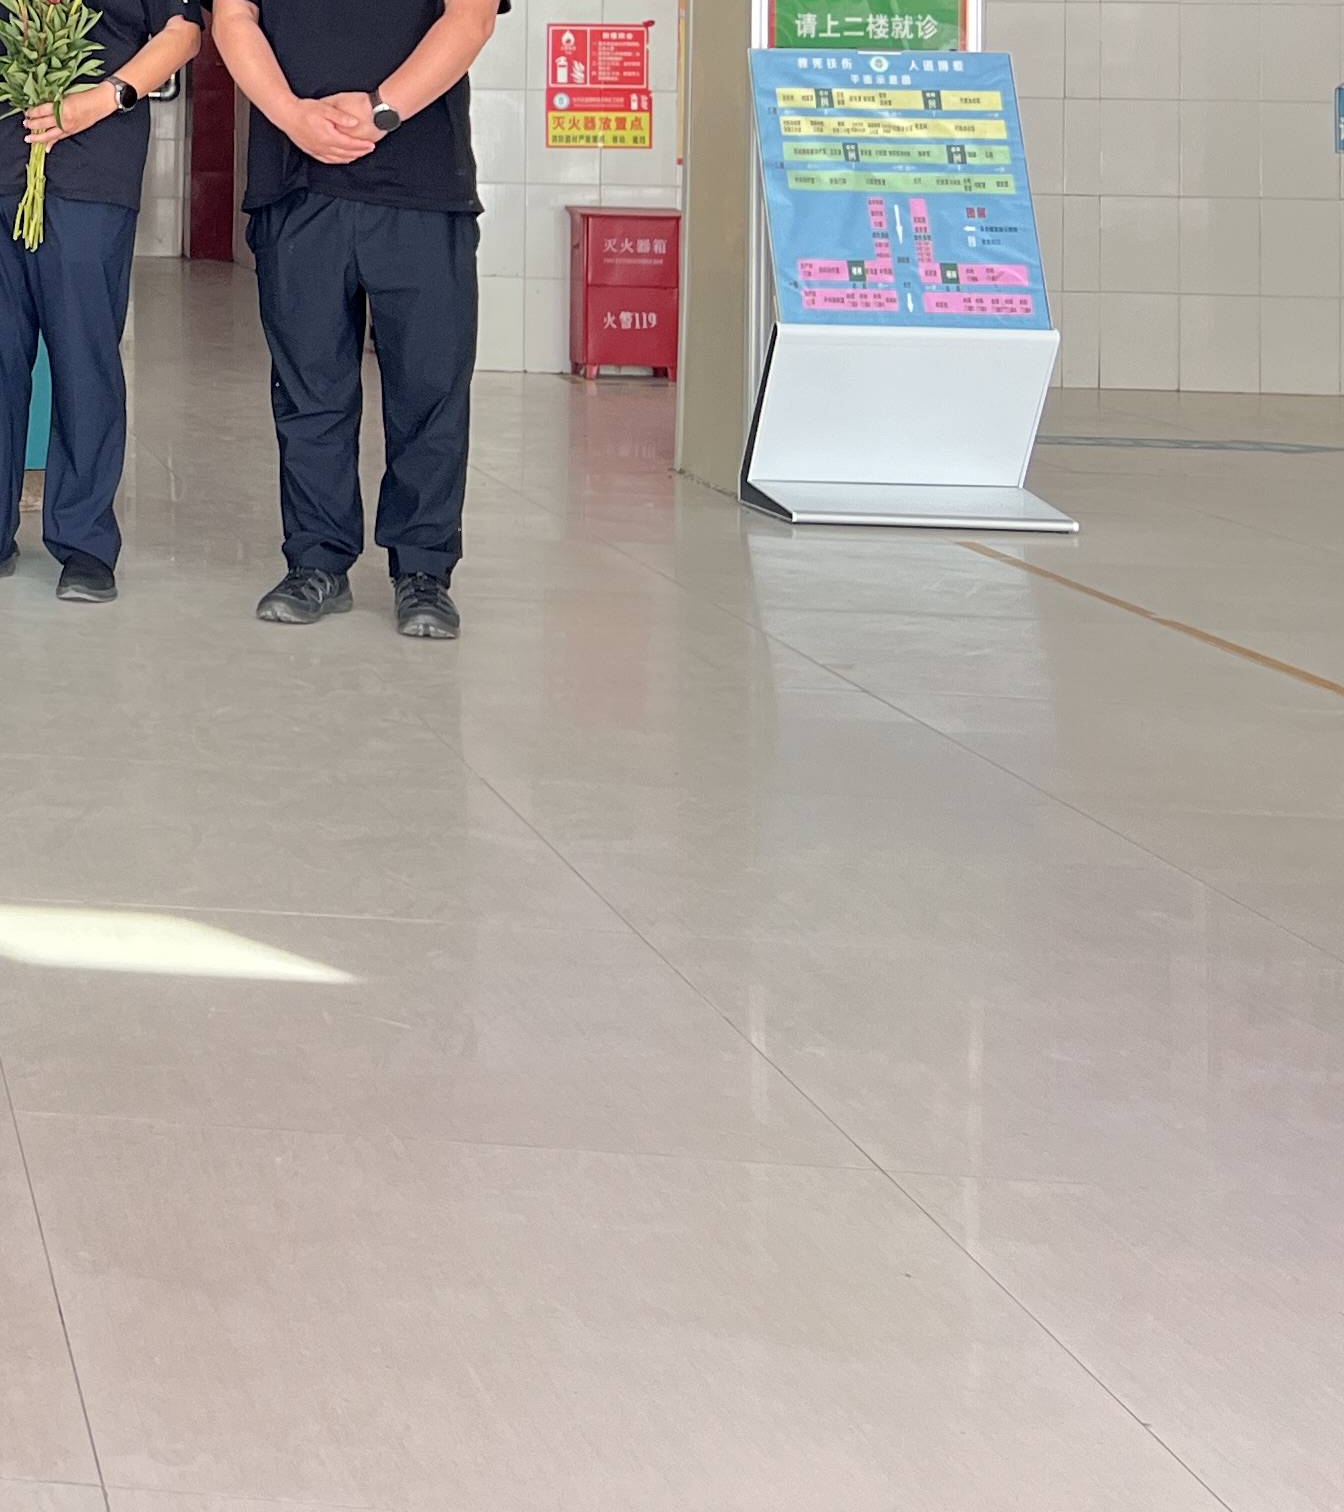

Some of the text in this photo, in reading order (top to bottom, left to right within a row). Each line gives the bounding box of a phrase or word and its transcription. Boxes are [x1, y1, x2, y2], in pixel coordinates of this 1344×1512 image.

[795, 14, 938, 39] 请上二楼就诊
[551, 115, 645, 131] 灭火器放置点
[603, 238, 667, 254] 灭火器箱
[603, 311, 658, 330] 火警119
